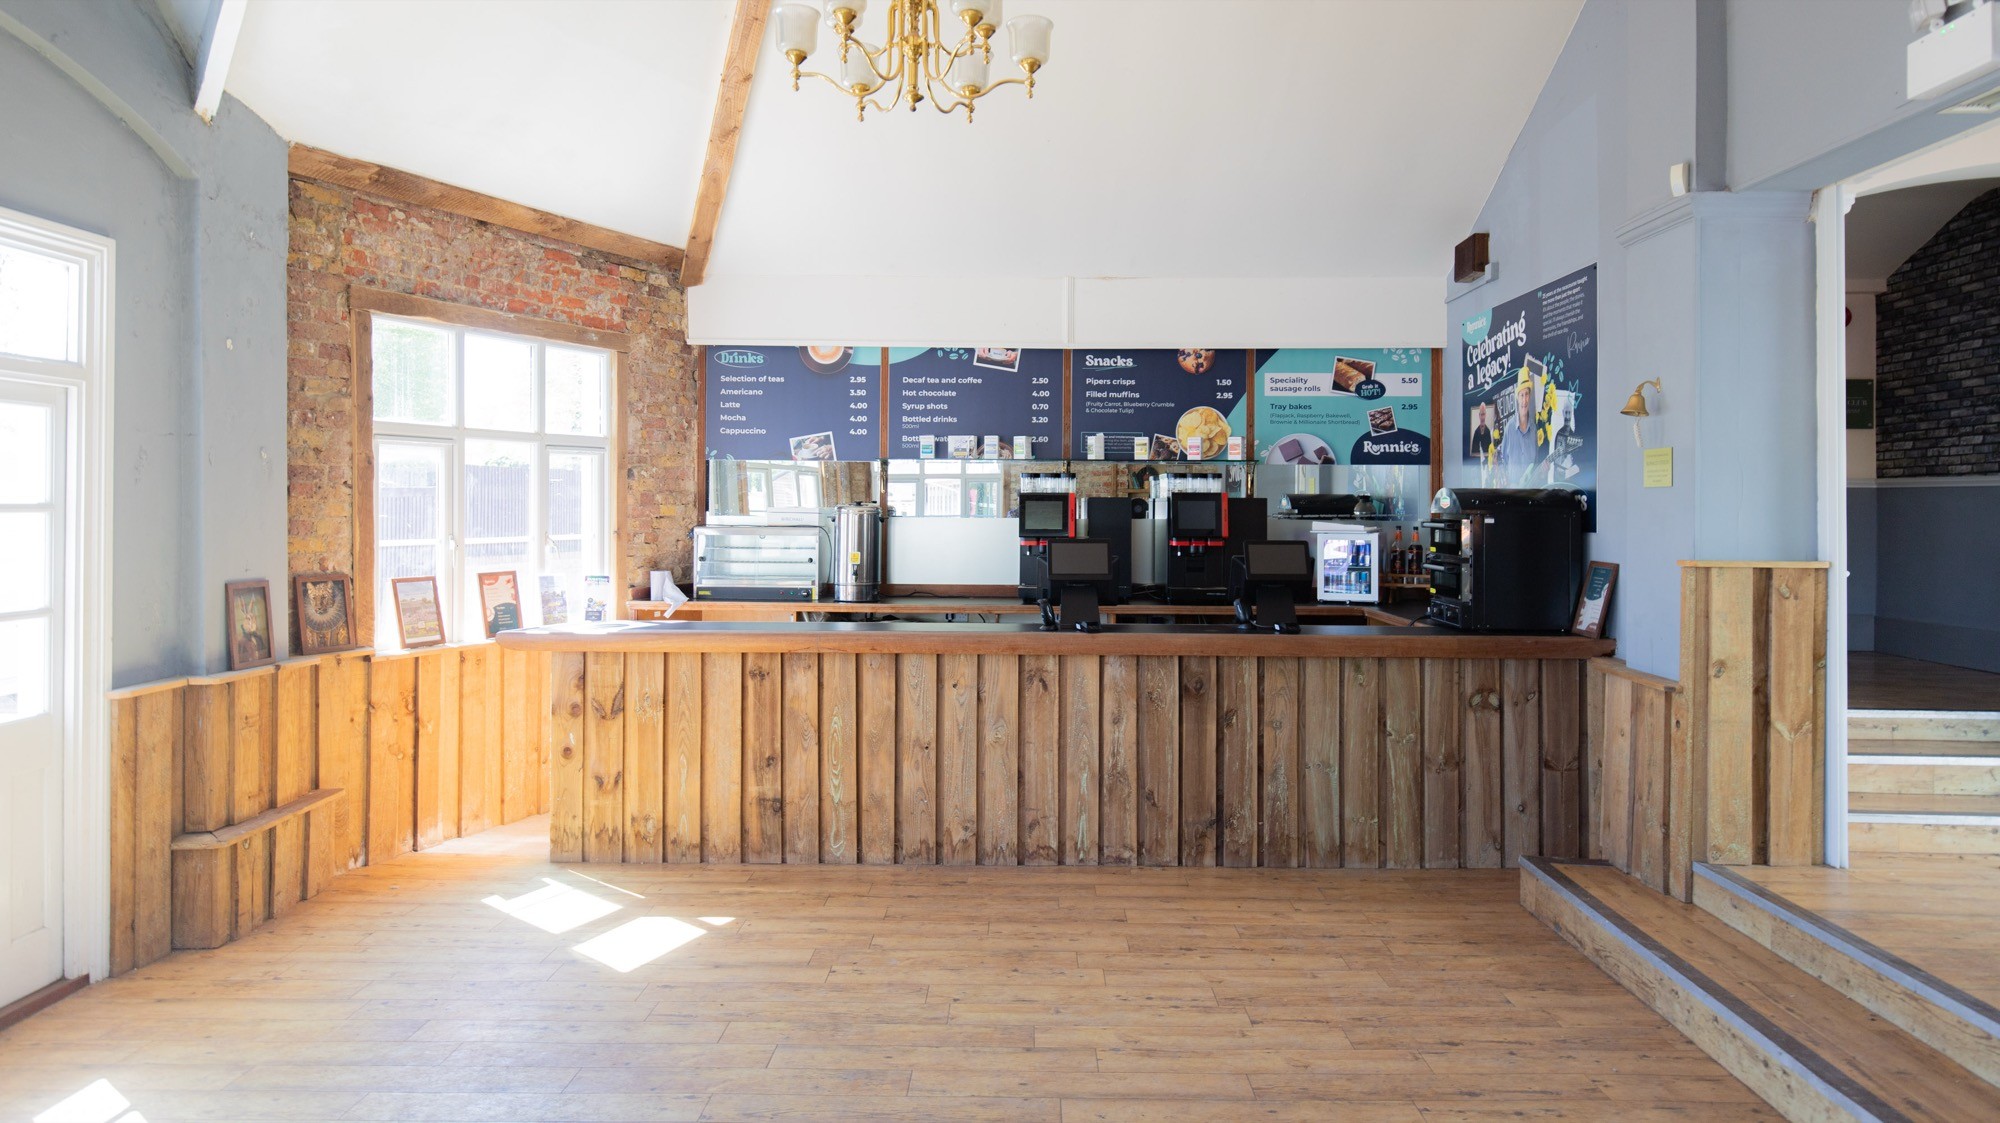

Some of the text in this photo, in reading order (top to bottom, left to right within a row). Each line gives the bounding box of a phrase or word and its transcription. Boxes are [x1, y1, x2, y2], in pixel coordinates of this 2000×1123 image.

[1467, 310, 1526, 367] Celebrating
[721, 352, 764, 364] Drinks
[1086, 355, 1133, 366] Snacks
[1468, 345, 1511, 390] a legacy!
[1364, 441, 1419, 455] Ronnie's
